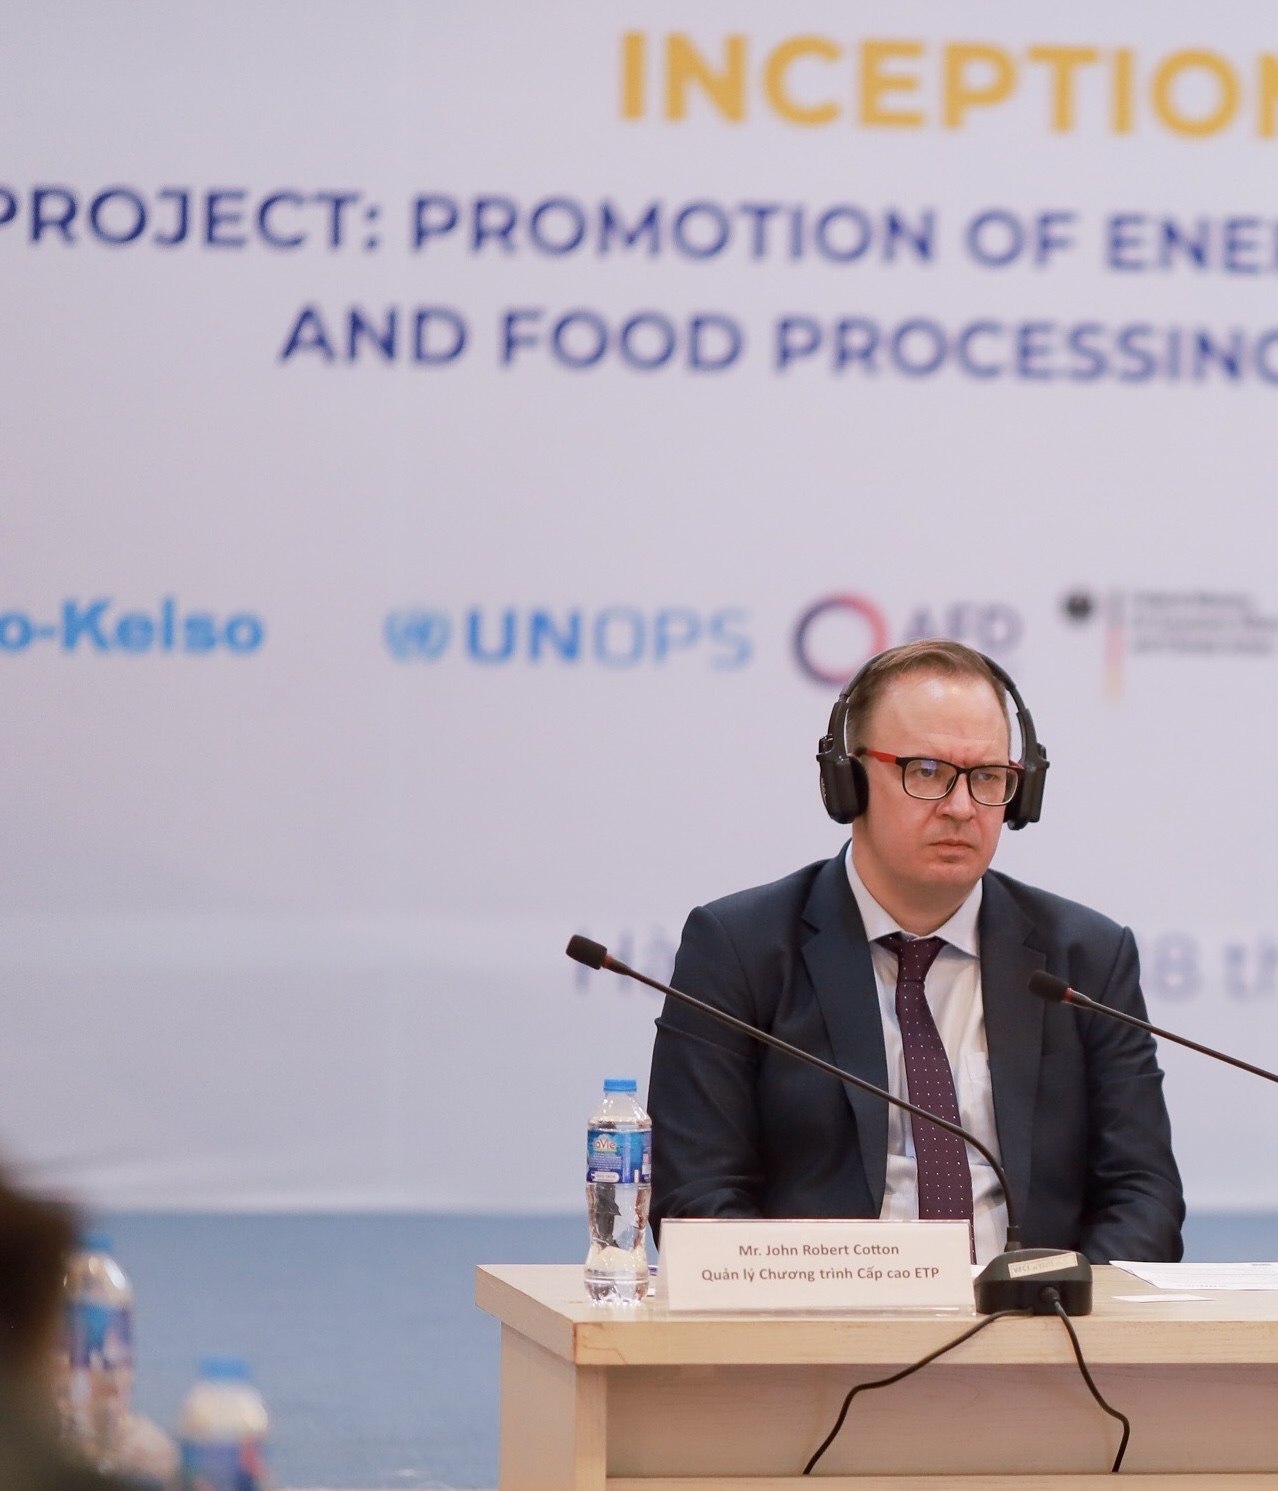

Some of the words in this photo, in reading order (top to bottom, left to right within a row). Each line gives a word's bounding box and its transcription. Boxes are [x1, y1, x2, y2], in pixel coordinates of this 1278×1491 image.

[410, 193, 935, 265] PROMOTION
[963, 209, 1076, 270] OF
[279, 304, 468, 366] AND
[499, 308, 745, 374] FOOD
[465, 606, 754, 669] UNOPS
[702, 1266, 739, 1282] Quản
[743, 1267, 755, 1283] lý
[759, 1267, 815, 1283] Chương
[820, 1267, 853, 1280] trình
[857, 1264, 882, 1282] Cấp
[887, 1269, 911, 1280] cao
[915, 1267, 939, 1279] ETP
[739, 1245, 761, 1256] Mr.
[766, 1244, 798, 1256] John
[803, 1244, 849, 1256] Robert
[853, 1244, 899, 1256] Cotton
